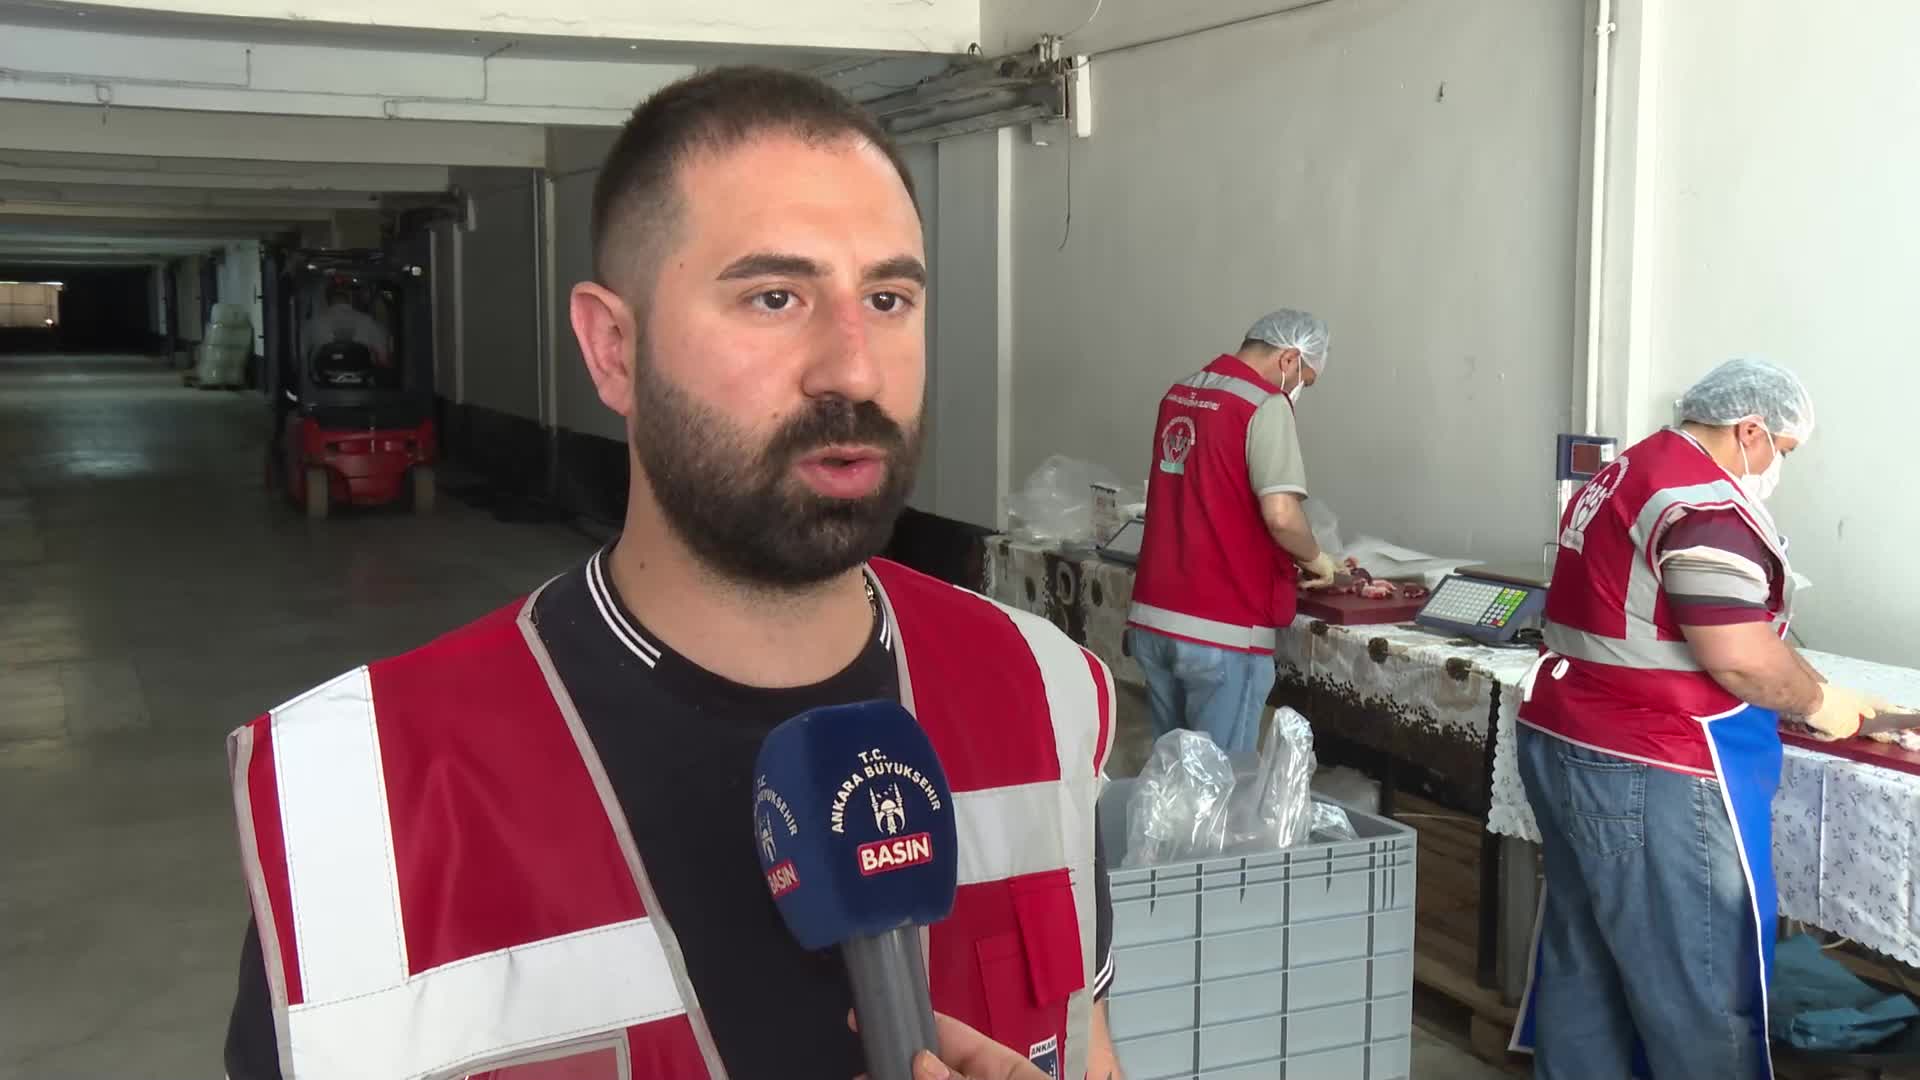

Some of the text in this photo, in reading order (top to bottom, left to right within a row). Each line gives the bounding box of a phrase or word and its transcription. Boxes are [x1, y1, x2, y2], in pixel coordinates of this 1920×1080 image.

[858, 748, 887, 764] T.C.
[831, 773, 864, 833] ANKARA
[861, 837, 930, 871] BASIN
